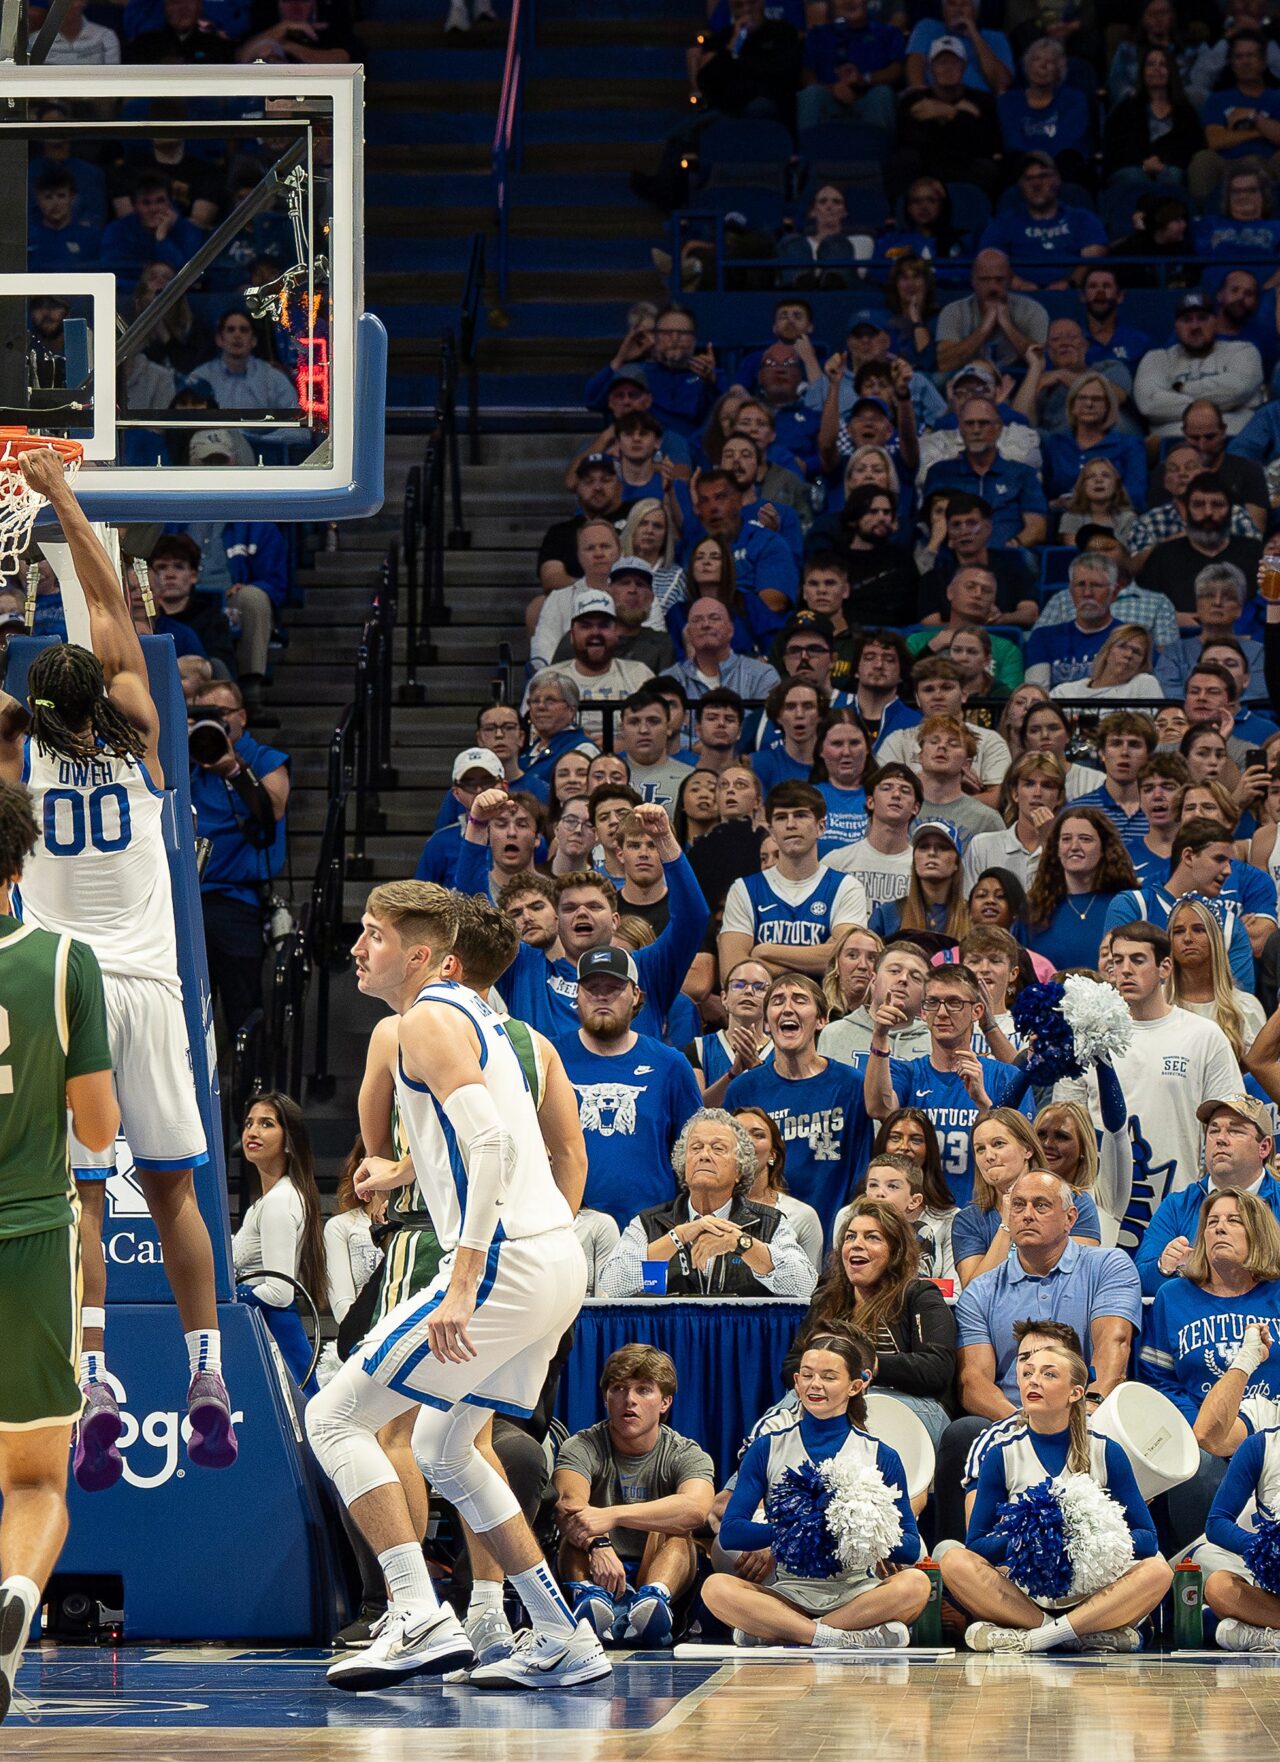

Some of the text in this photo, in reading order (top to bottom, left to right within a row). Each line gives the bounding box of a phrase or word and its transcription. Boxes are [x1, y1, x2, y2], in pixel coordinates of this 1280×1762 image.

[59, 758, 114, 787] OWEH
[43, 782, 132, 857] 00
[1164, 1060, 1187, 1073] SEC
